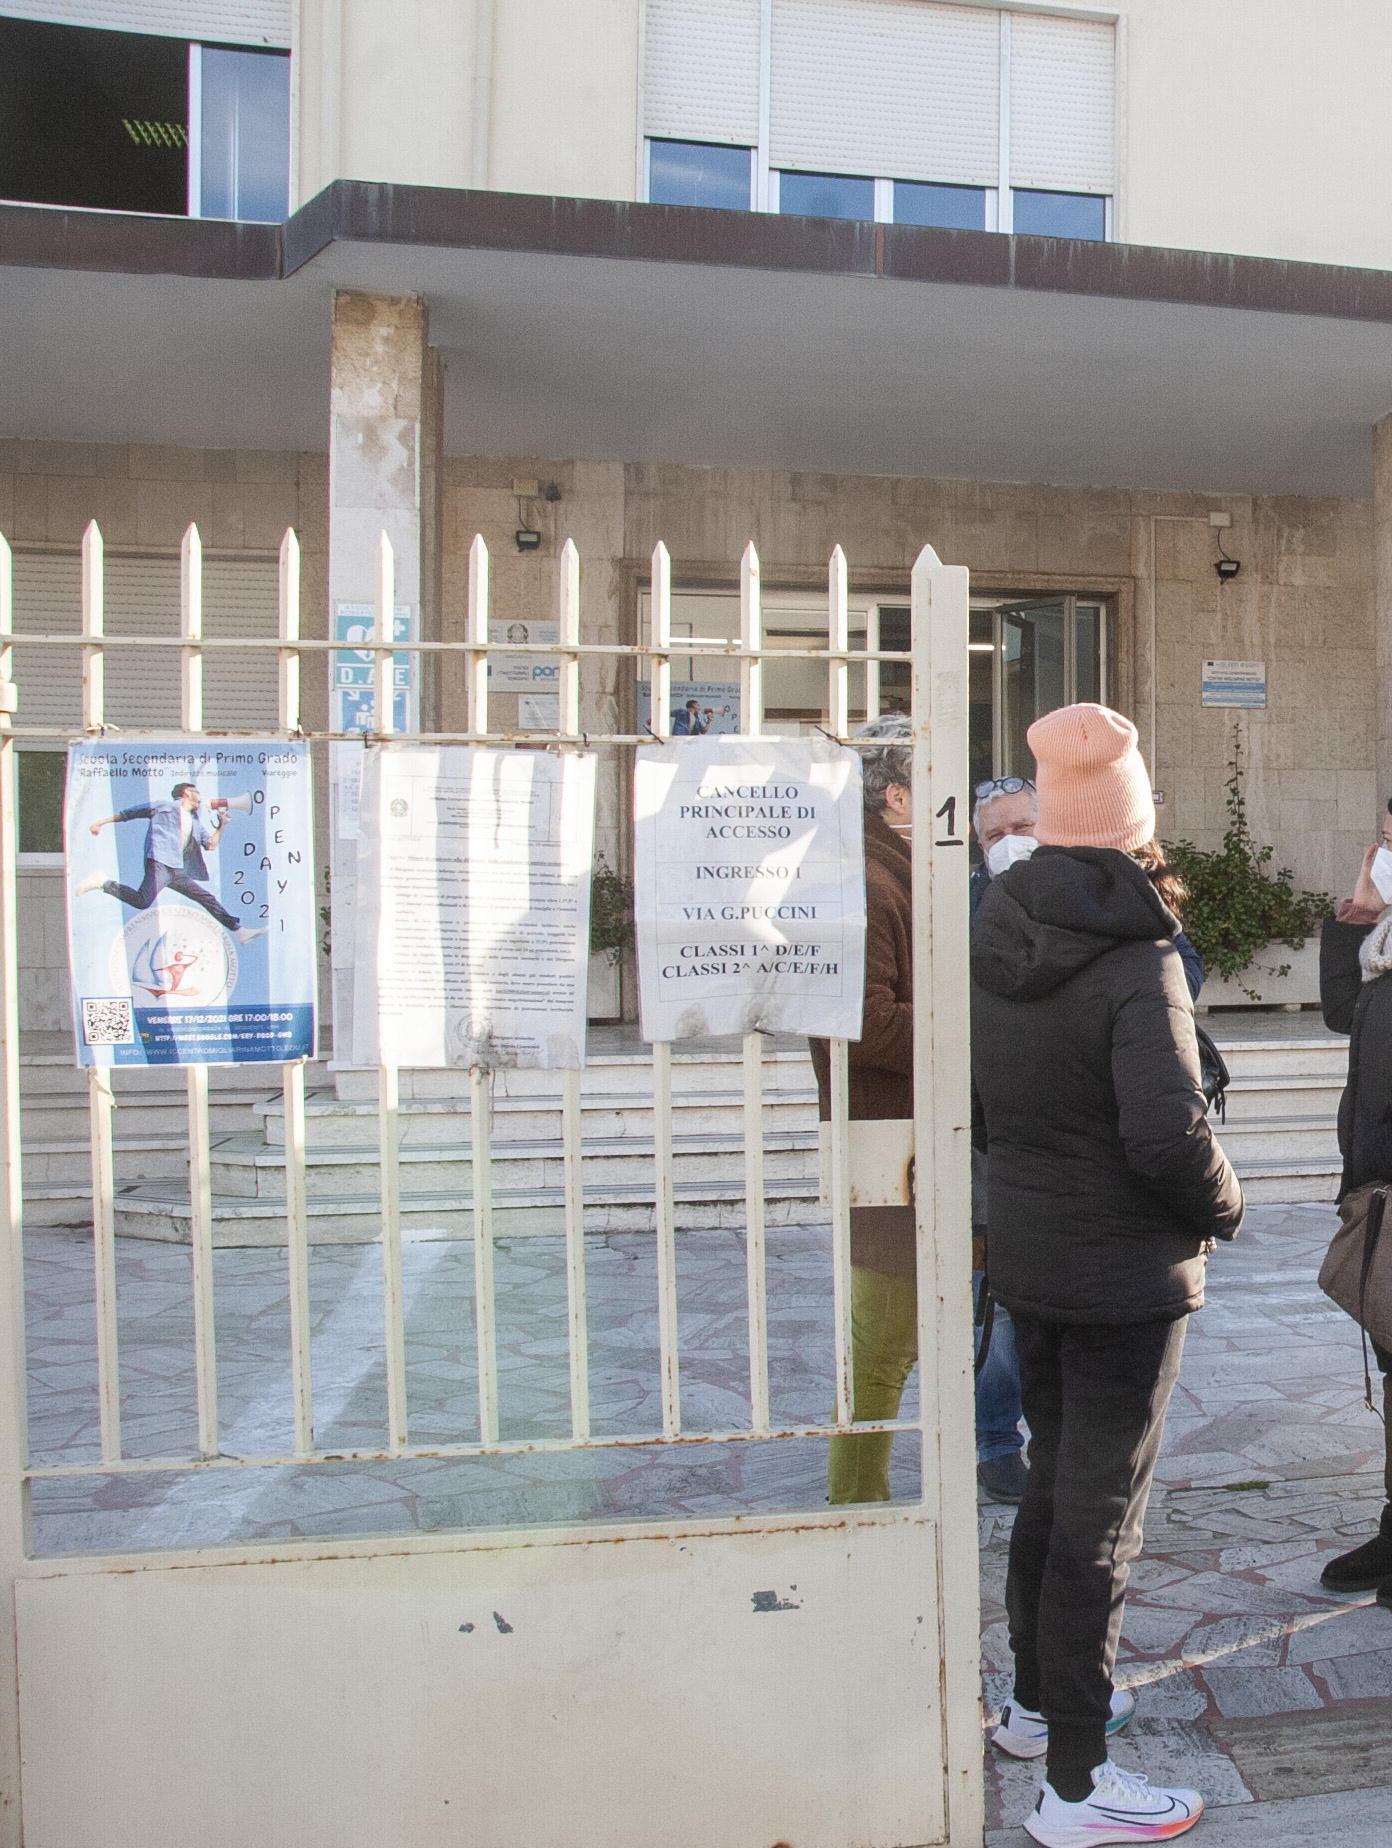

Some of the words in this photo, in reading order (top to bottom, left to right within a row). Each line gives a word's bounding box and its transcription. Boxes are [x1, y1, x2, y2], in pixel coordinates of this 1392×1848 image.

[79, 753, 118, 765] Scuola
[122, 752, 195, 765] Secondaria
[200, 752, 211, 764] di
[216, 752, 254, 764] Primo
[258, 752, 298, 764] Grado
[696, 785, 799, 800] CANCELLO
[679, 805, 792, 820] PRINCIPALE
[797, 806, 816, 820] DI
[936, 796, 956, 836] 1
[706, 825, 792, 840] ACCESSO
[695, 865, 789, 880] INGRESSO
[682, 907, 717, 921] VIA
[721, 905, 818, 921] G.PUCCINI
[680, 944, 746, 959] CLASSI
[752, 944, 769, 956] 1^
[775, 944, 822, 957] D/E/F
[662, 963, 726, 979] CLASSI
[732, 962, 751, 975] 2^
[756, 961, 839, 976] A/C/E/F/H
